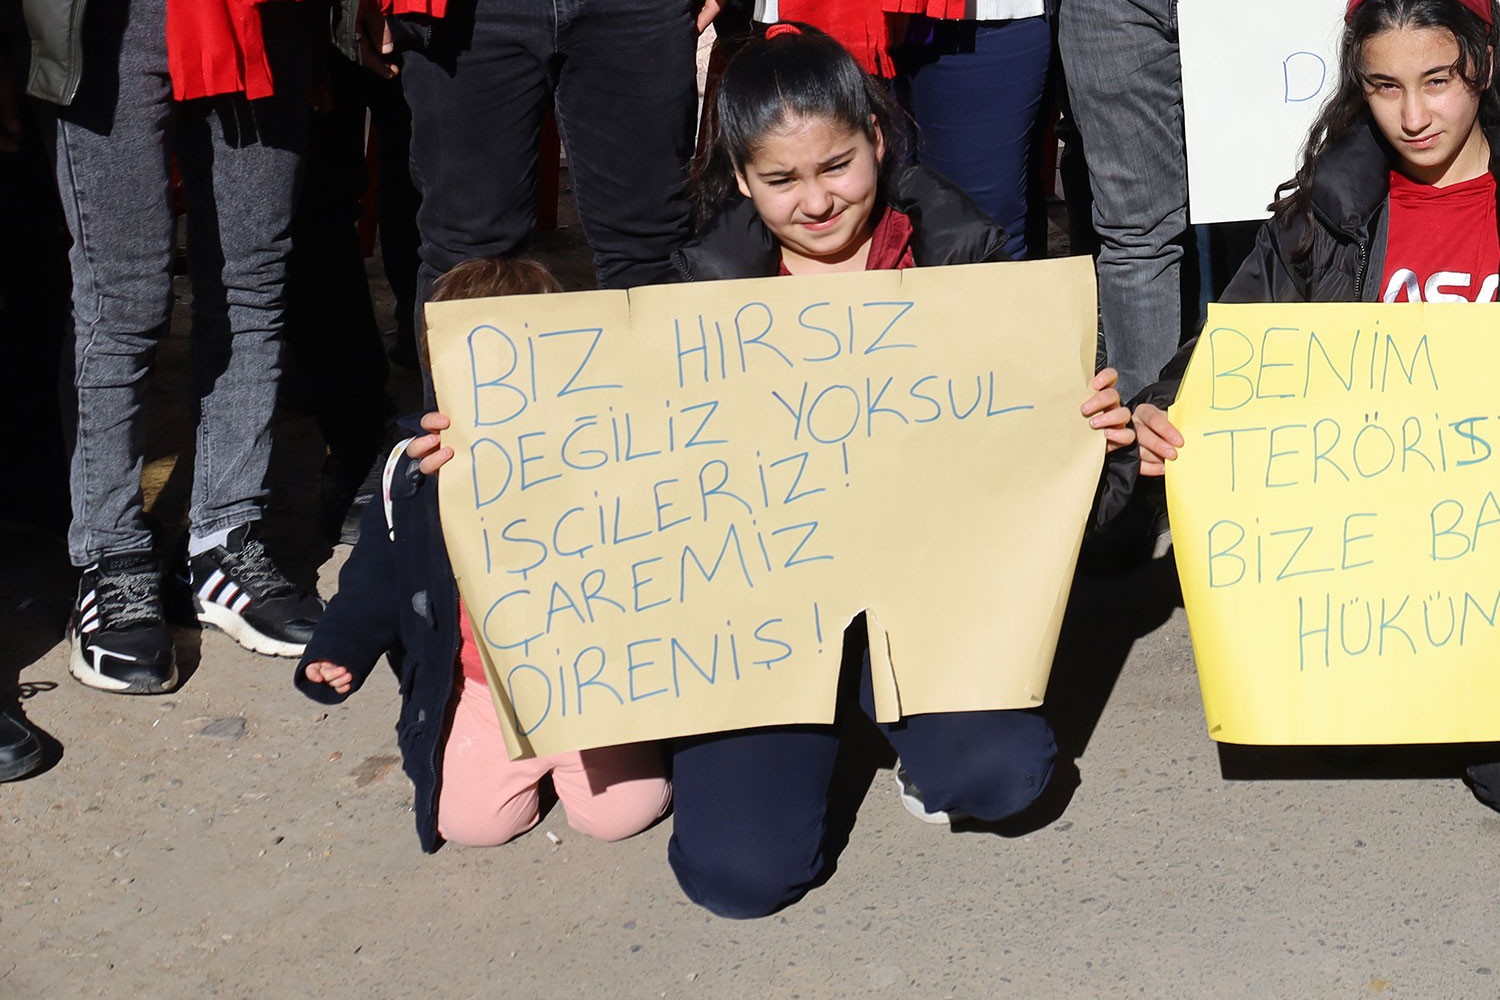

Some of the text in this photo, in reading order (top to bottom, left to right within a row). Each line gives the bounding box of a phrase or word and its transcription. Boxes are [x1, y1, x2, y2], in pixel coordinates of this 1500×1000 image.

[466, 301, 918, 429] BİZ HIRSIZ
[1208, 319, 1440, 411] BENİM
[470, 370, 1035, 510] DEĞİLİZ YOKSUL
[482, 519, 835, 657] ÇAREMİZ
[1208, 513, 1378, 588] BİZE
